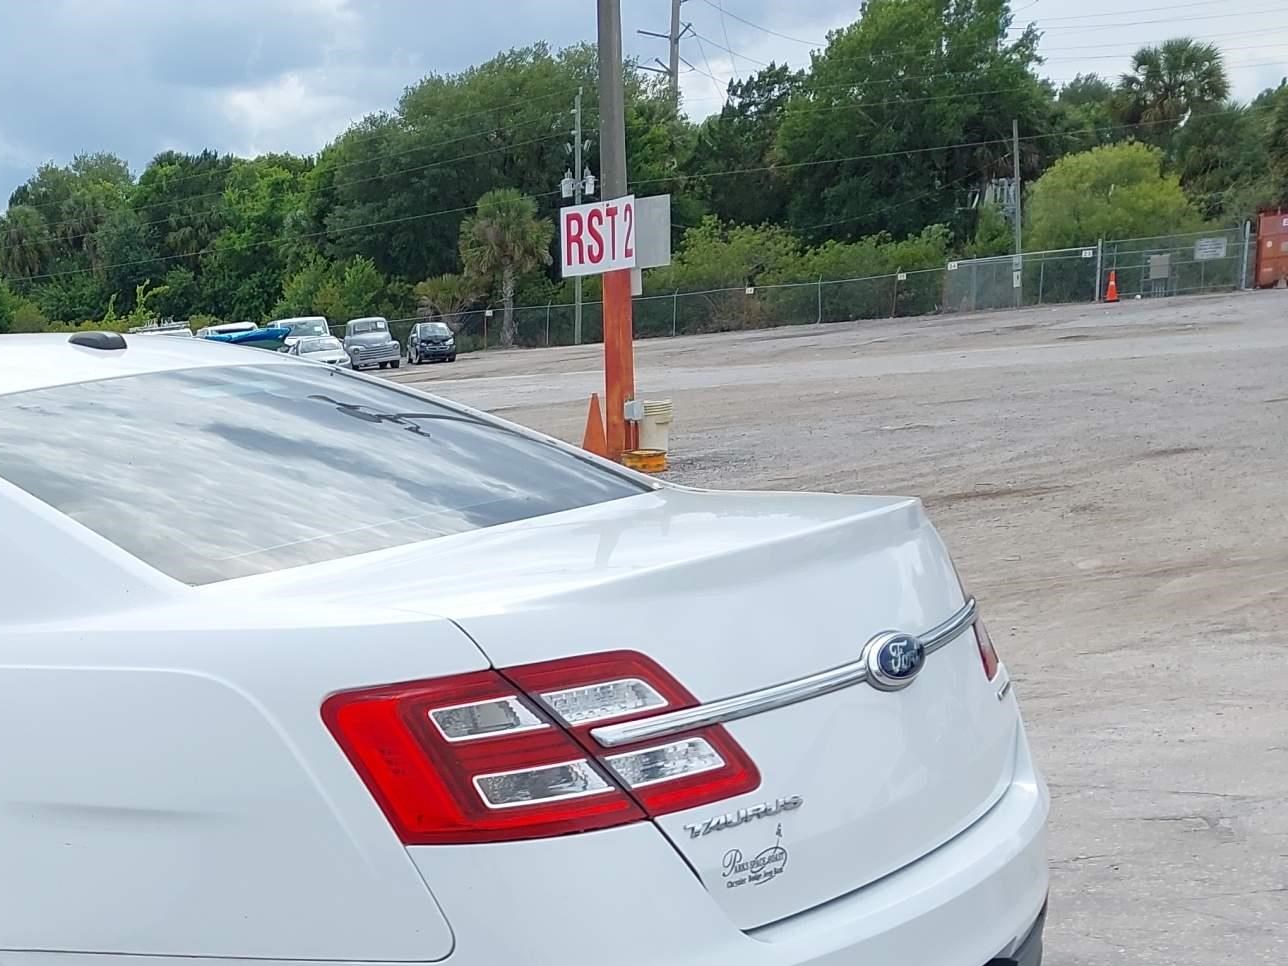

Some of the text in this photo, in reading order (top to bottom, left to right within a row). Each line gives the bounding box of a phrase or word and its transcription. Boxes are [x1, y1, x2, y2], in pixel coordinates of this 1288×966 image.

[565, 203, 633, 266] RST 2
[683, 795, 803, 839] TAURUS
